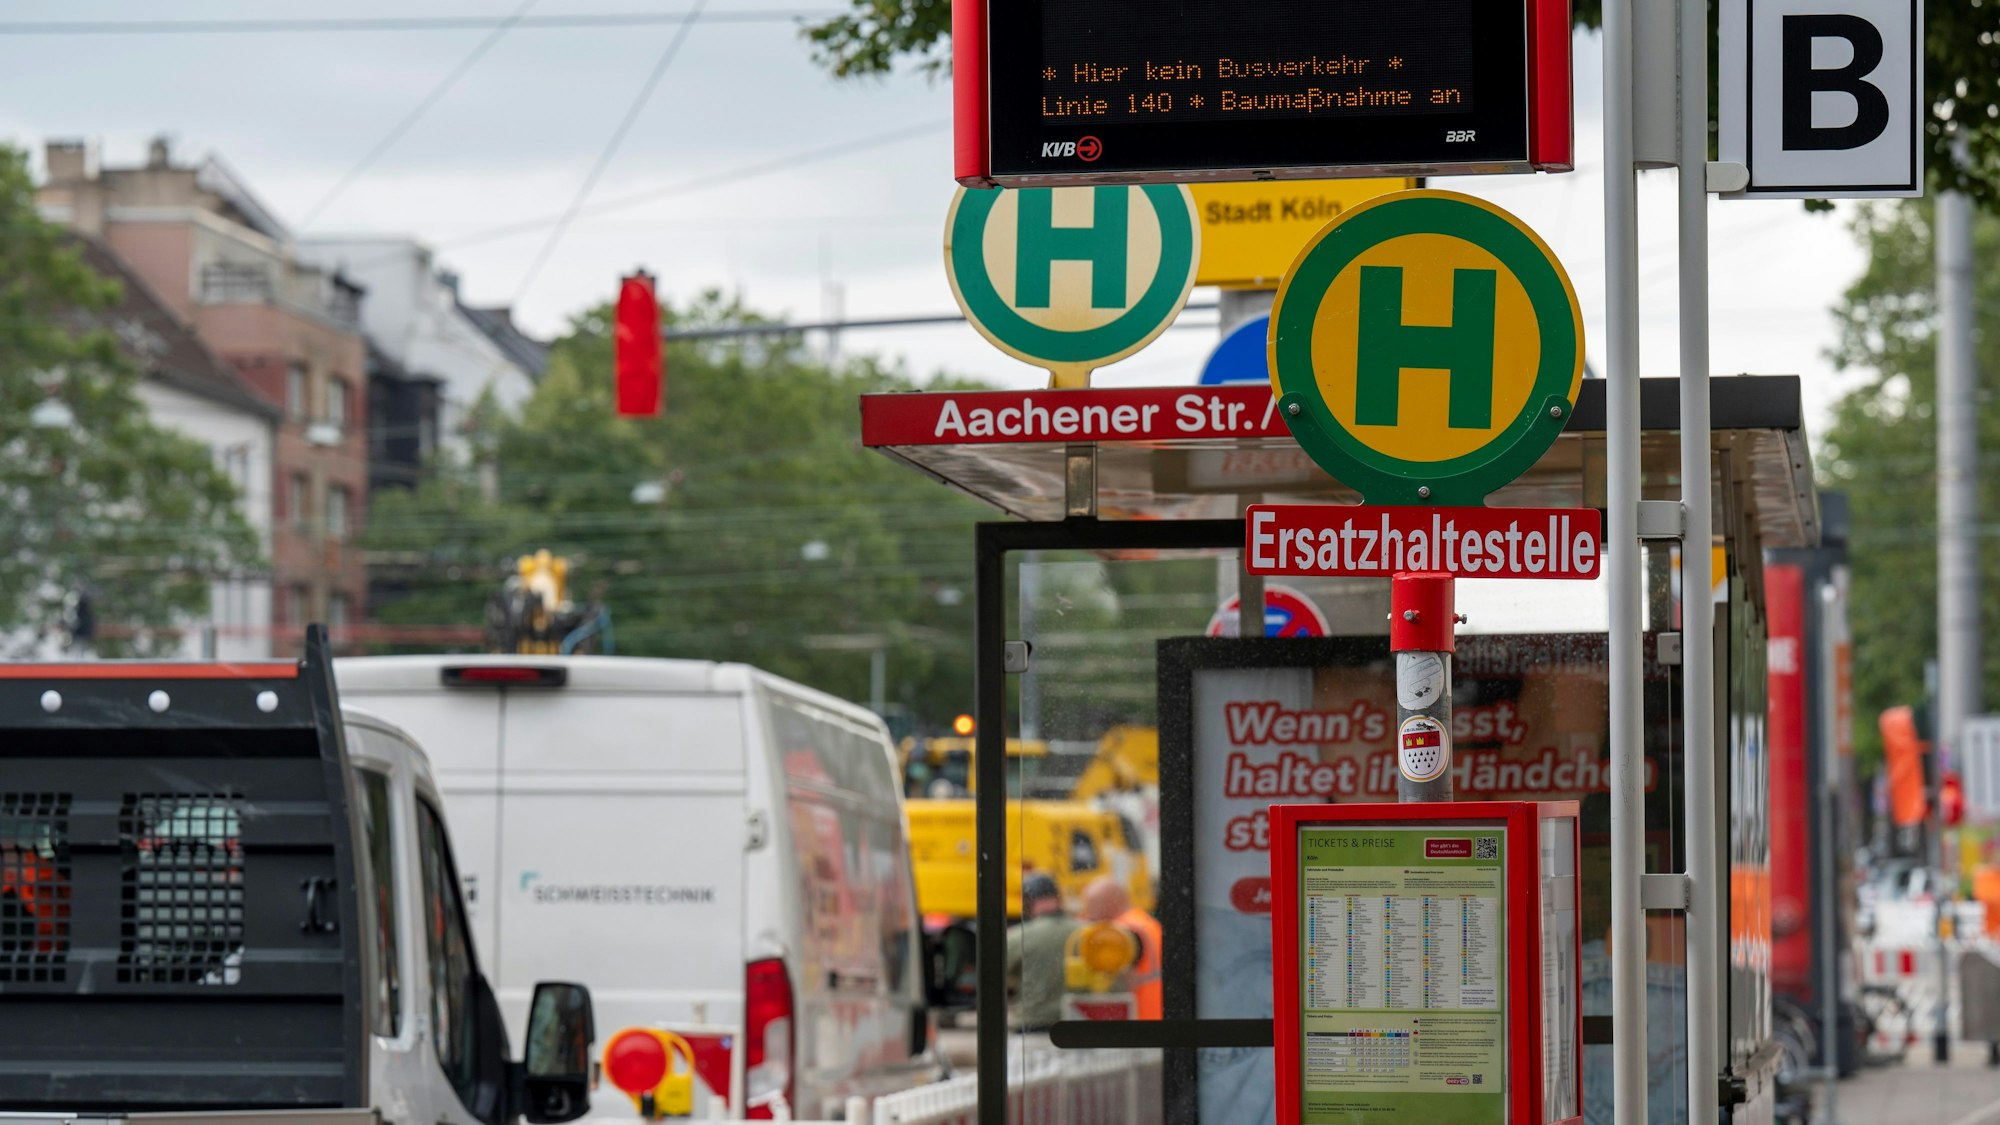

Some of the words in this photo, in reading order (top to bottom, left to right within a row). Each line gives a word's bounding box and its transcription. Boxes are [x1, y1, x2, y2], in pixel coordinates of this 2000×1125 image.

[1074, 62, 1129, 83] Hier
[1146, 60, 1201, 81] kein
[1218, 55, 1370, 78] Busverkehr
[1782, 14, 1890, 151] B
[1042, 95, 1108, 116] Linie
[1128, 92, 1172, 113] 140
[1221, 86, 1412, 113] Baumaßnahme
[1429, 89, 1460, 104] an
[1041, 141, 1076, 158] KVB
[1445, 130, 1476, 143] BBR
[1205, 200, 1271, 225] Stadt
[1281, 196, 1342, 221] Köln
[1015, 186, 1129, 309] H
[1355, 265, 1497, 430] H
[935, 396, 1160, 438] Aachener
[1251, 511, 1595, 574] Ersatzhaltestelle
[1453, 703, 1523, 742] sst,
[1228, 754, 1356, 794] haltet
[1368, 753, 1399, 794] ih
[1453, 750, 1652, 791] Händch
[1308, 838, 1348, 848] TICKETS
[1351, 838, 1360, 848] &
[1362, 838, 1396, 848] PREISE
[534, 885, 716, 904] SCHWEISSTECHNIK
